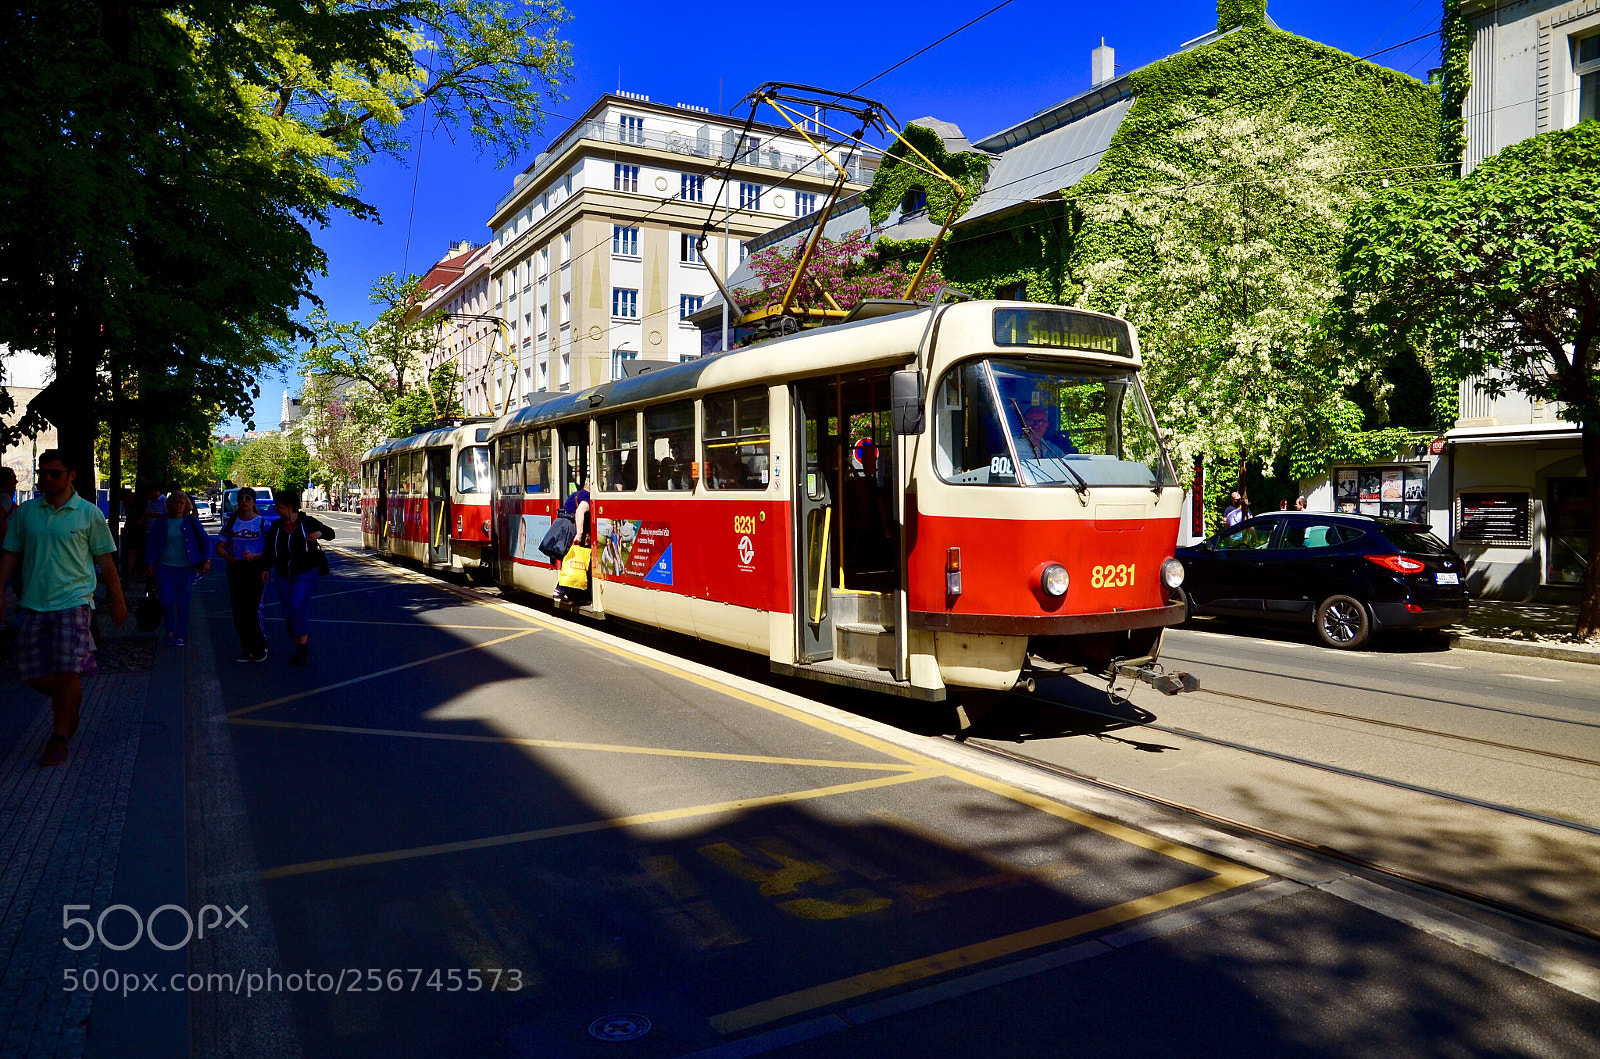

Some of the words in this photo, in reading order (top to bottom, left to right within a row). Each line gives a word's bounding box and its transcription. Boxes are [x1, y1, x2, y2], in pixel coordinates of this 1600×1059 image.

[1004, 313, 1017, 344] 1
[734, 515, 756, 535] 8231
[1091, 564, 1137, 589] 8231
